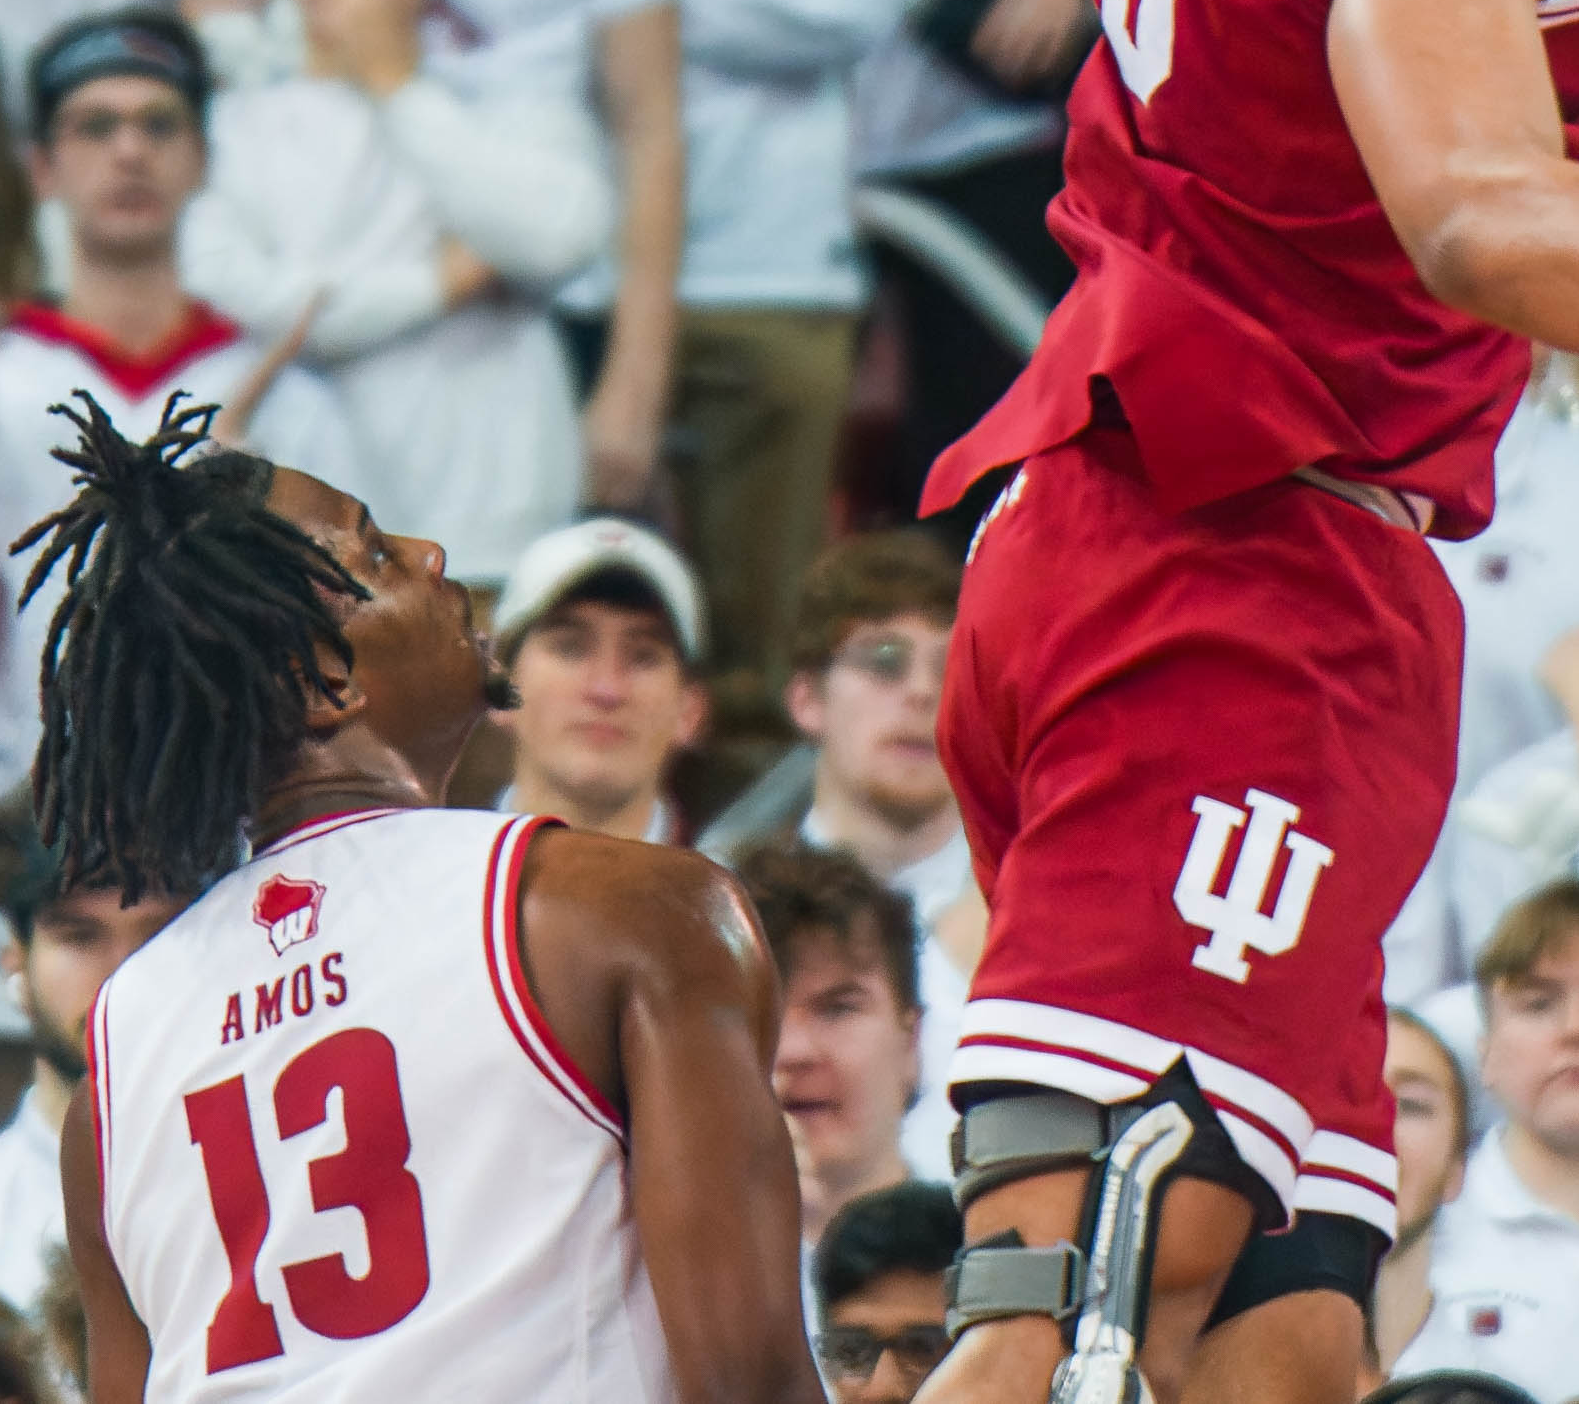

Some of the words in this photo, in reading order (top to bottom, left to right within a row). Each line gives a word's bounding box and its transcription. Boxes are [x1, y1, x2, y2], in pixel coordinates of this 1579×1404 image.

[268, 905, 312, 957] W
[221, 951, 349, 1045] AMOS
[184, 1027, 431, 1375] 13
